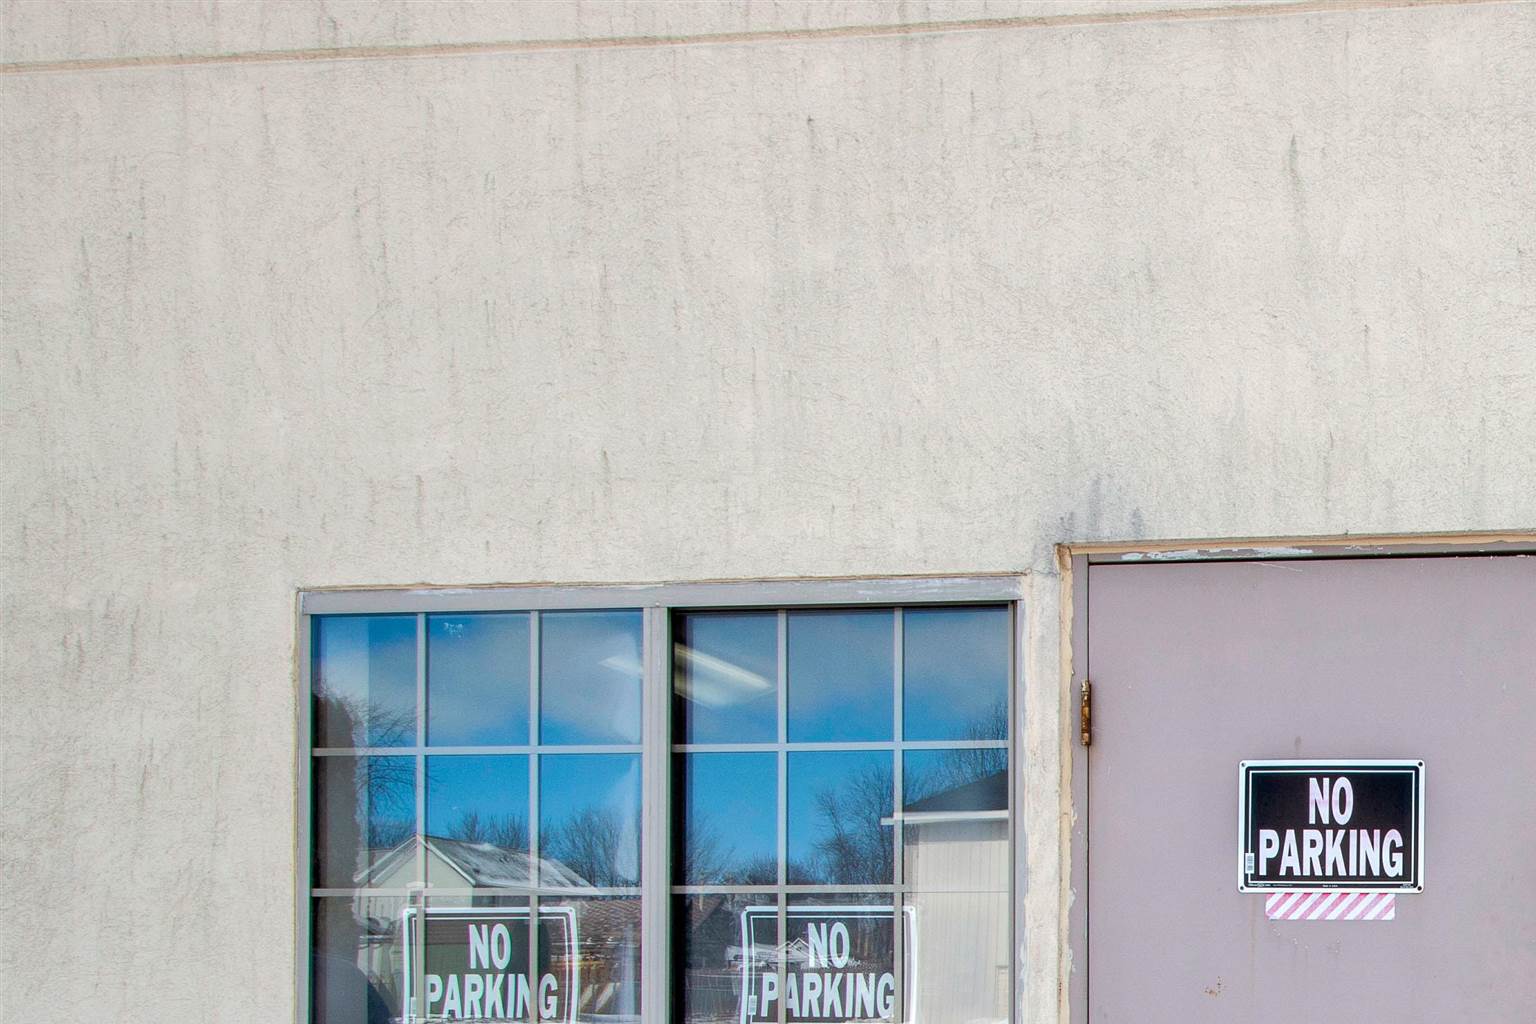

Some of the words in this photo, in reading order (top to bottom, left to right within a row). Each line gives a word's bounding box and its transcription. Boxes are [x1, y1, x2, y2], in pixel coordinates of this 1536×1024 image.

[1308, 776, 1354, 825] NO
[1258, 828, 1404, 877] PARKING
[468, 923, 512, 970] NO
[807, 921, 851, 969] NO
[425, 973, 558, 1020] PARKING
[761, 972, 896, 1019] PARKING
